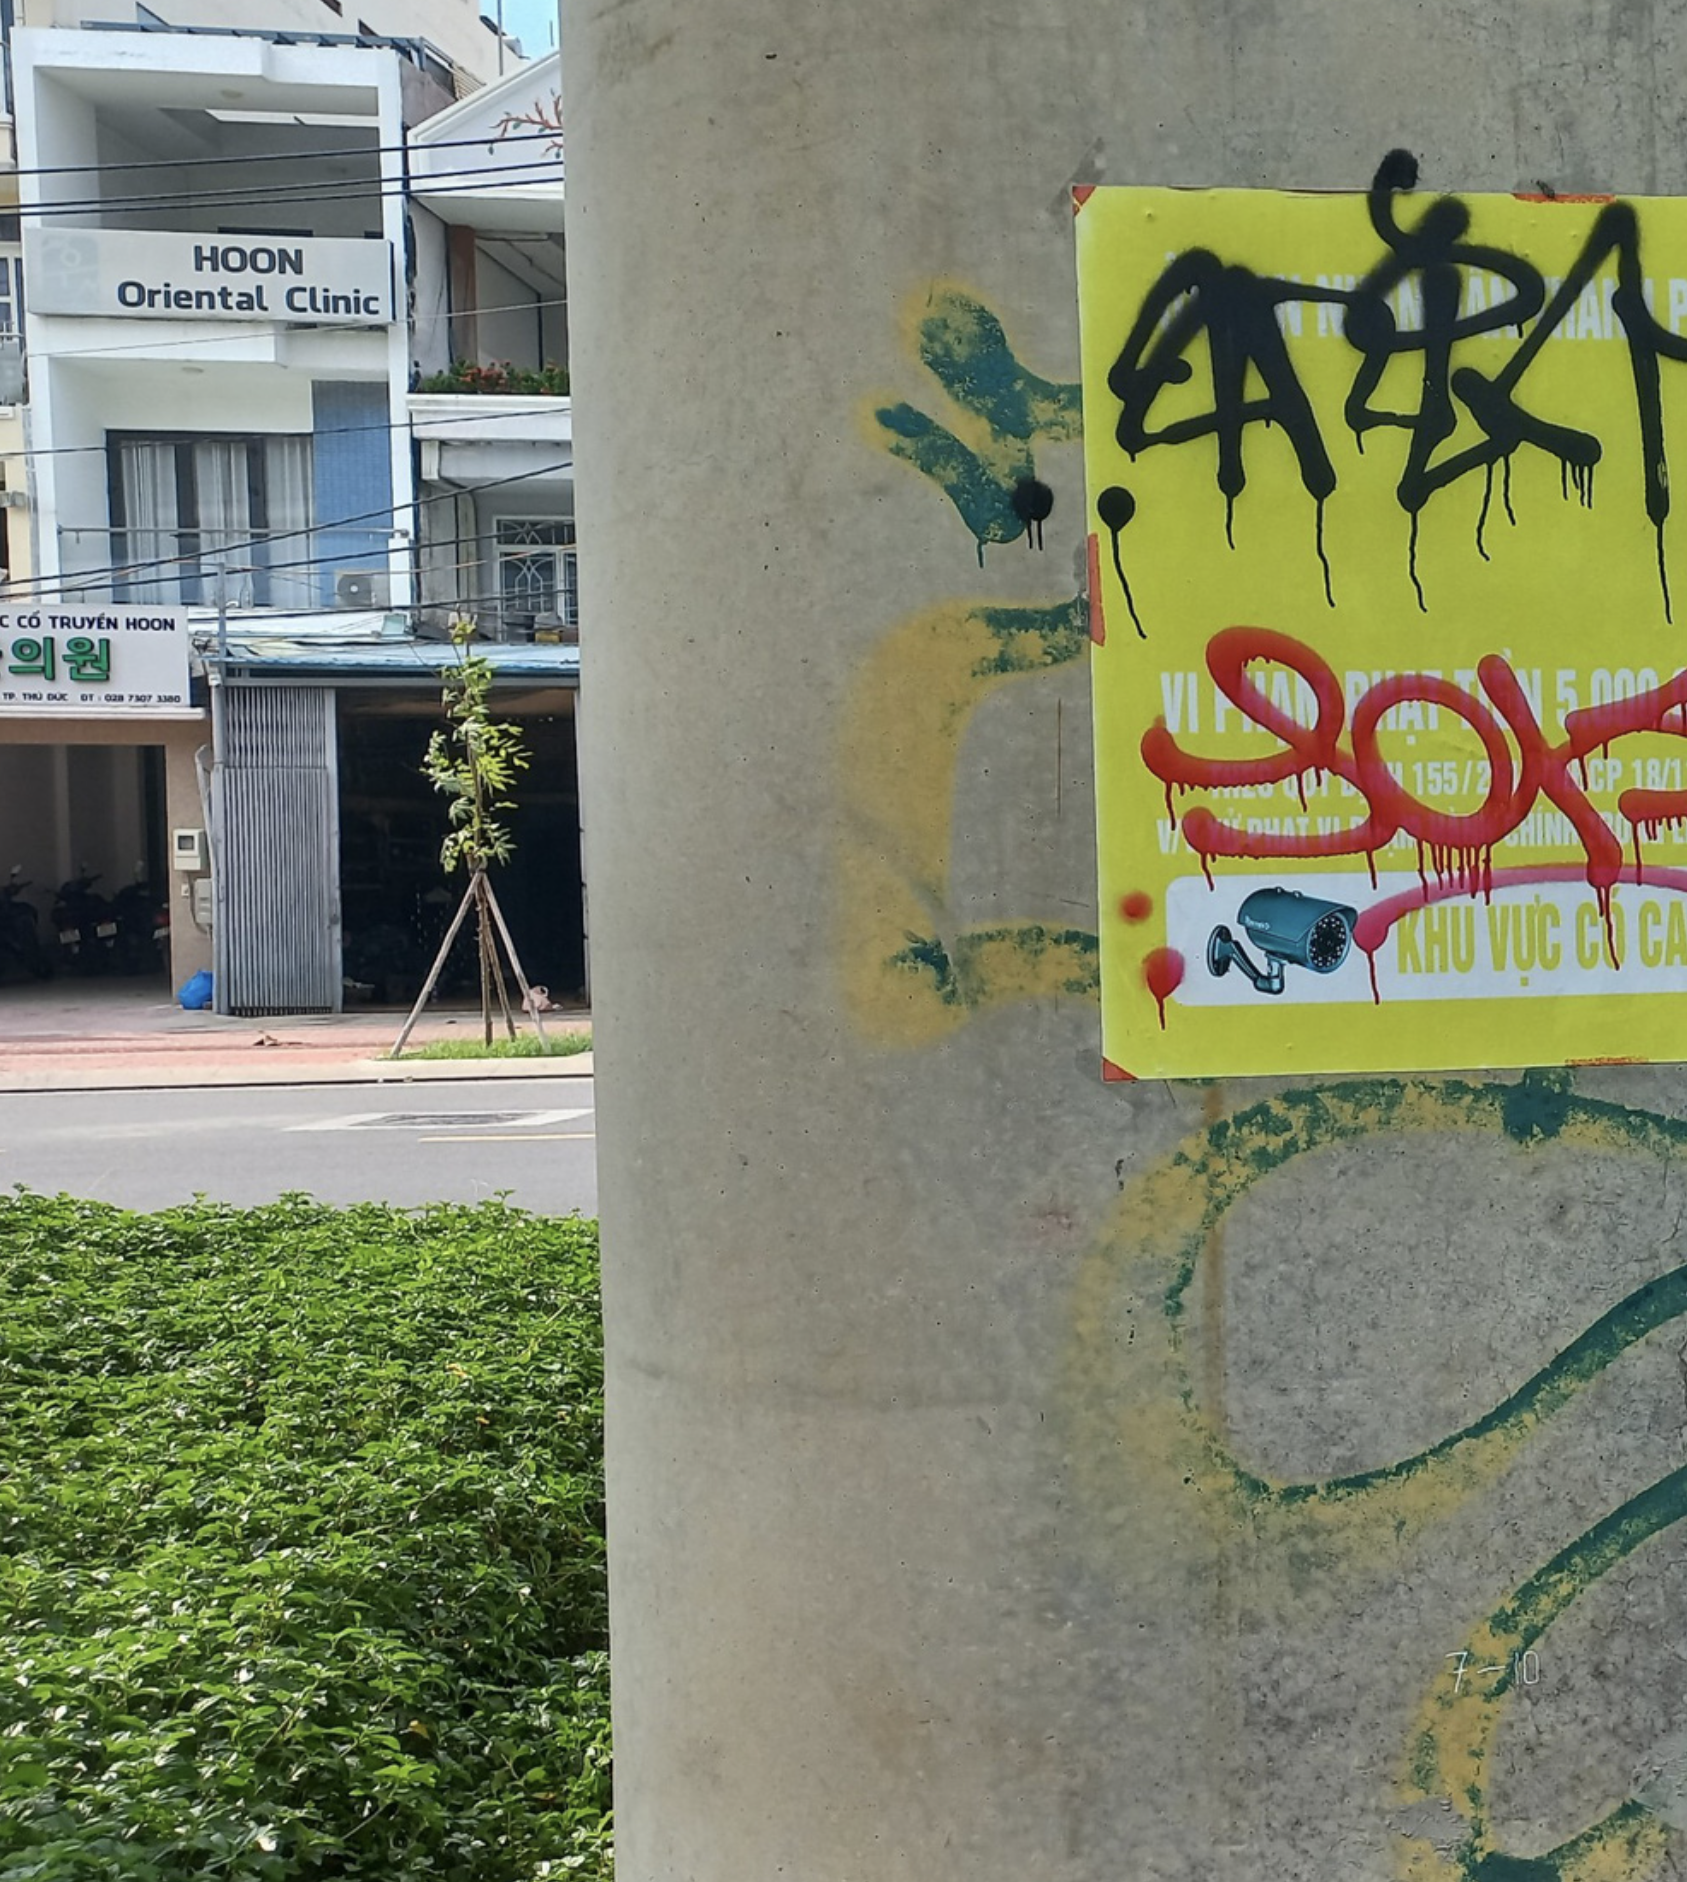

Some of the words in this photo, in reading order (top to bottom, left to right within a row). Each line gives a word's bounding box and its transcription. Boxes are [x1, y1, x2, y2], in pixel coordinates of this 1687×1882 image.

[194, 246, 303, 275] HOON
[117, 281, 268, 311] Oriental
[285, 287, 380, 315] Clinic
[126, 618, 175, 631] HOON
[0, 636, 111, 682] 의원
[1160, 671, 1199, 734] VI
[1397, 905, 1475, 974] KHU
[1487, 894, 1562, 987] VỰC
[1575, 886, 1626, 971] CÓ
